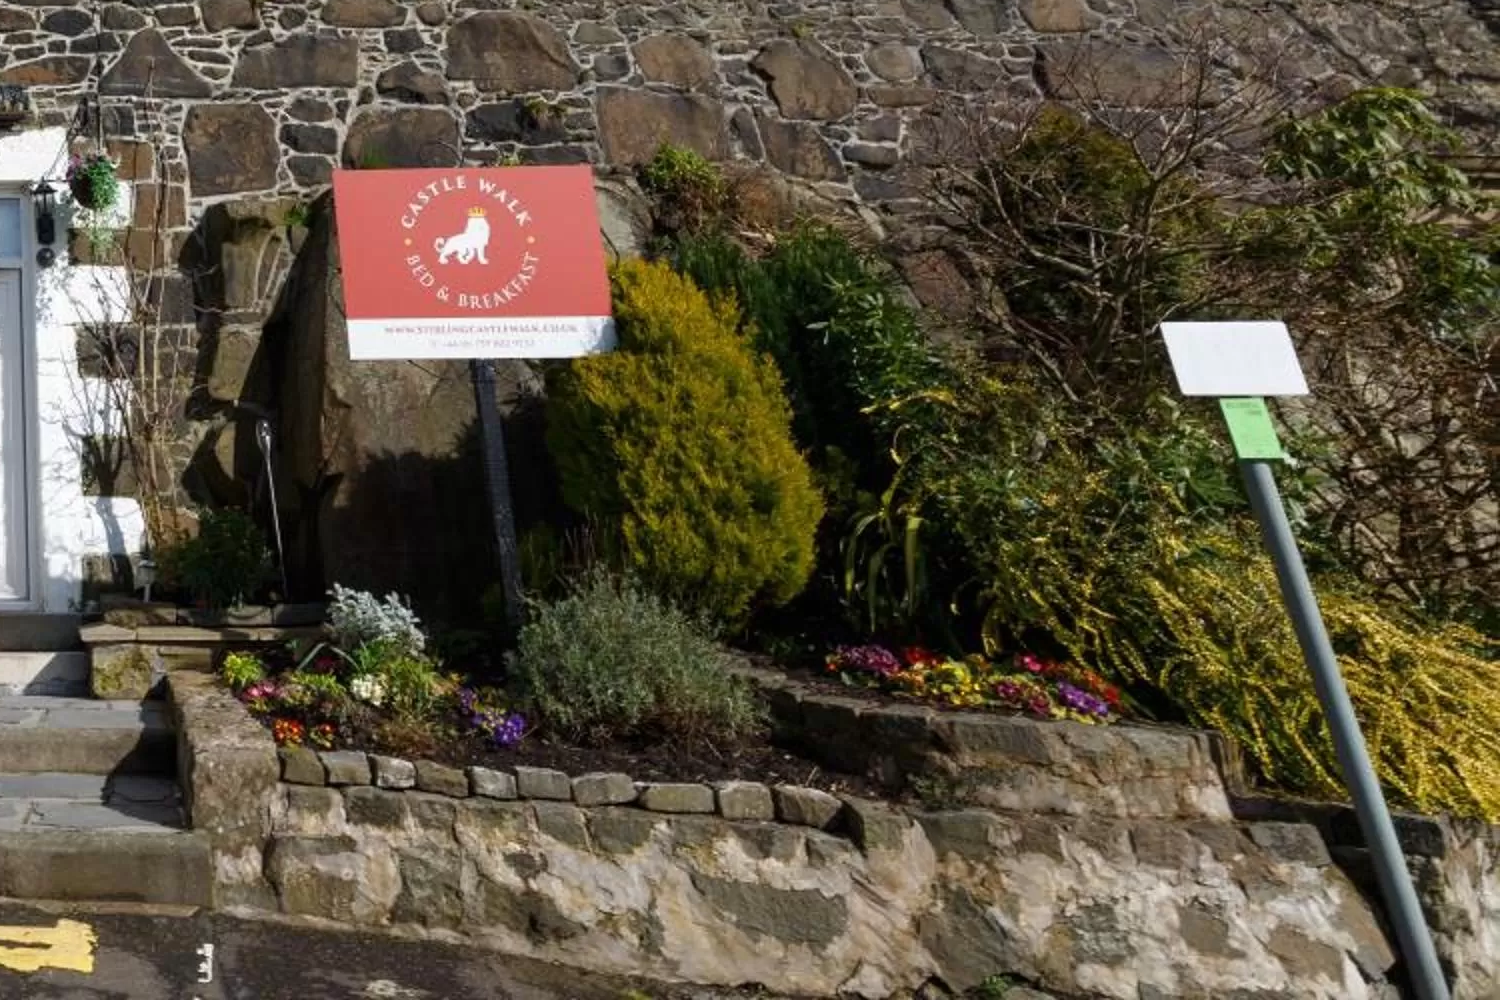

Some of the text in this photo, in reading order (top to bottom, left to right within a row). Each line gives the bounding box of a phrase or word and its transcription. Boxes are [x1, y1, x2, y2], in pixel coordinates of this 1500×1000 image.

[401, 175, 532, 229] CASTLE WALK
[405, 251, 539, 309] BED & BREAKFAST
